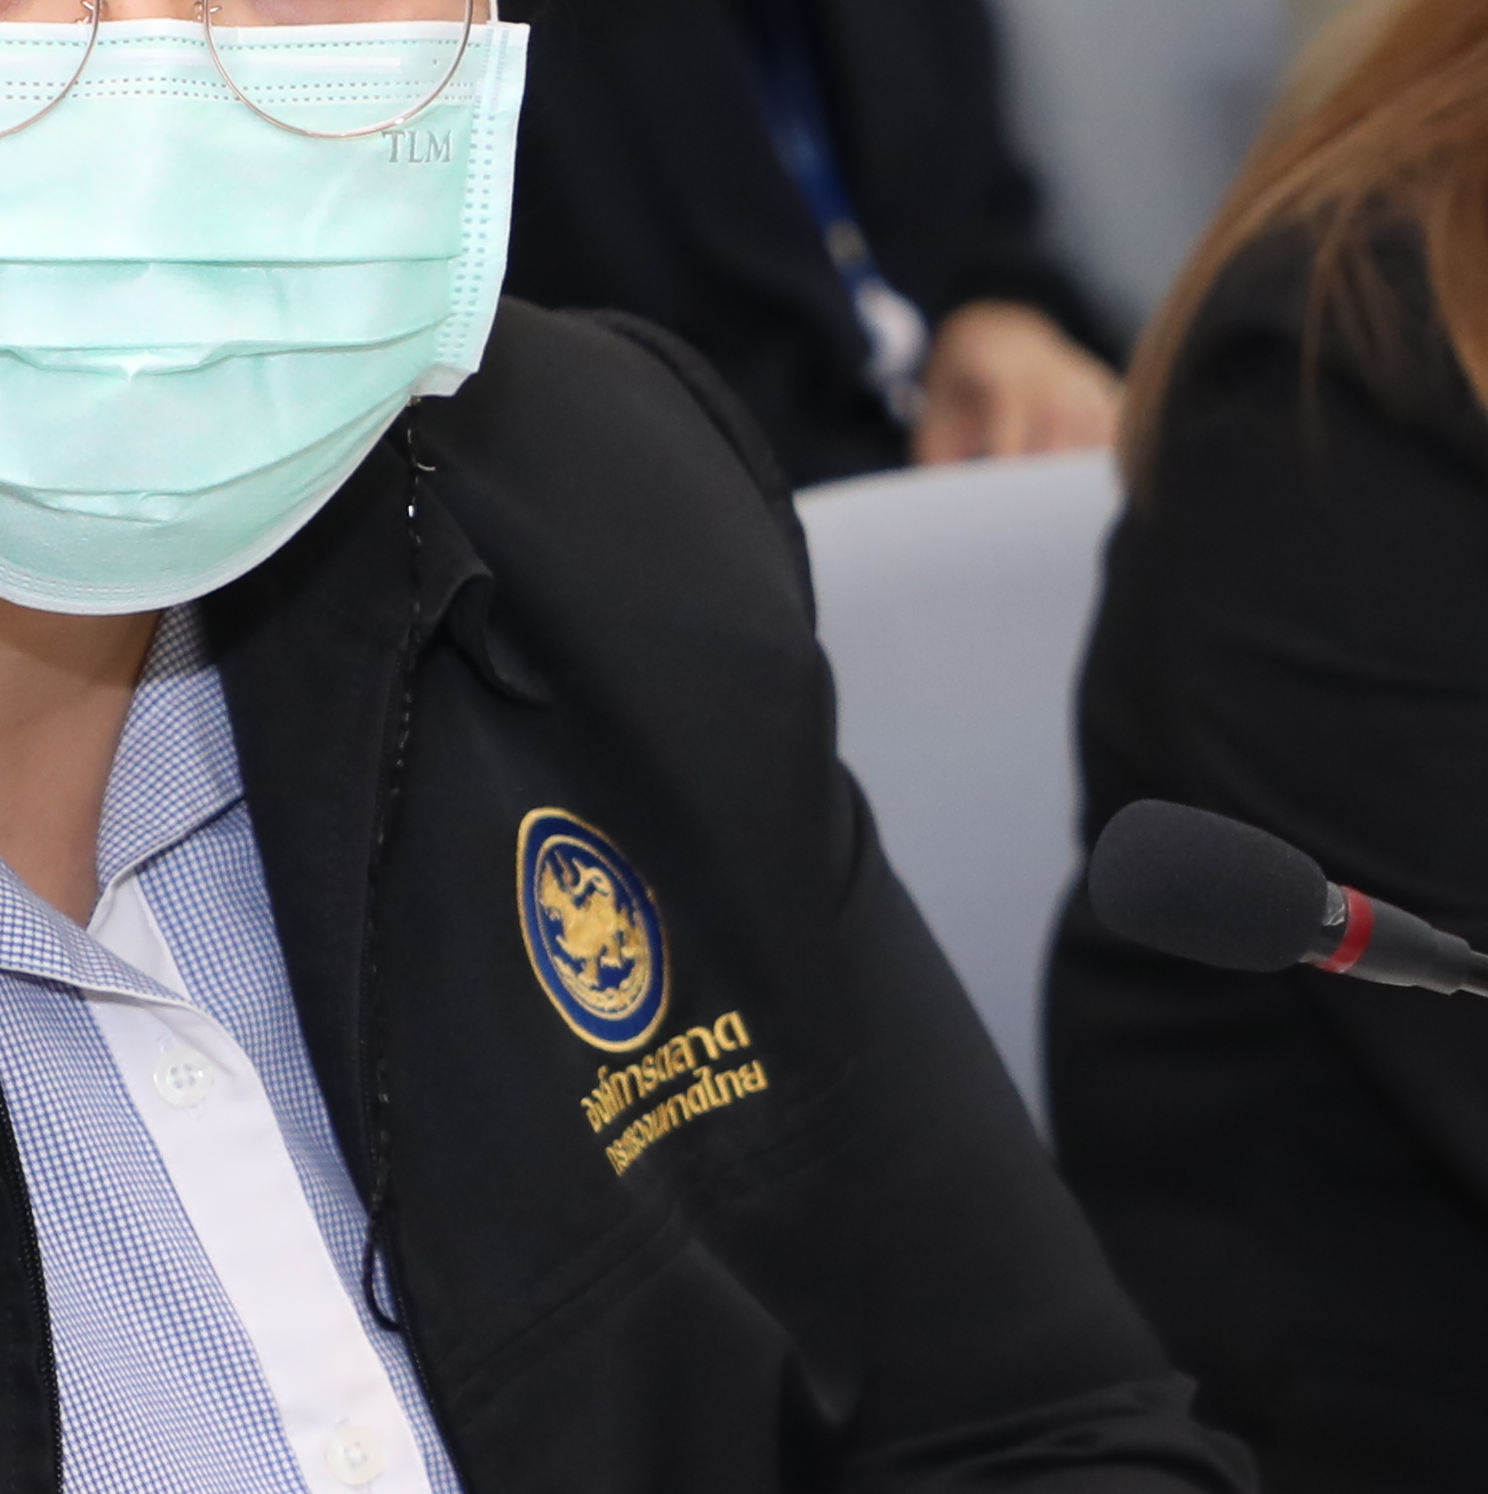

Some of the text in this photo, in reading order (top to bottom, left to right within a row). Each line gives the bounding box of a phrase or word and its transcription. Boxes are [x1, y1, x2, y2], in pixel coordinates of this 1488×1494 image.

[381, 129, 452, 164] TLM
[580, 1010, 752, 1134] องค์การตลาด
